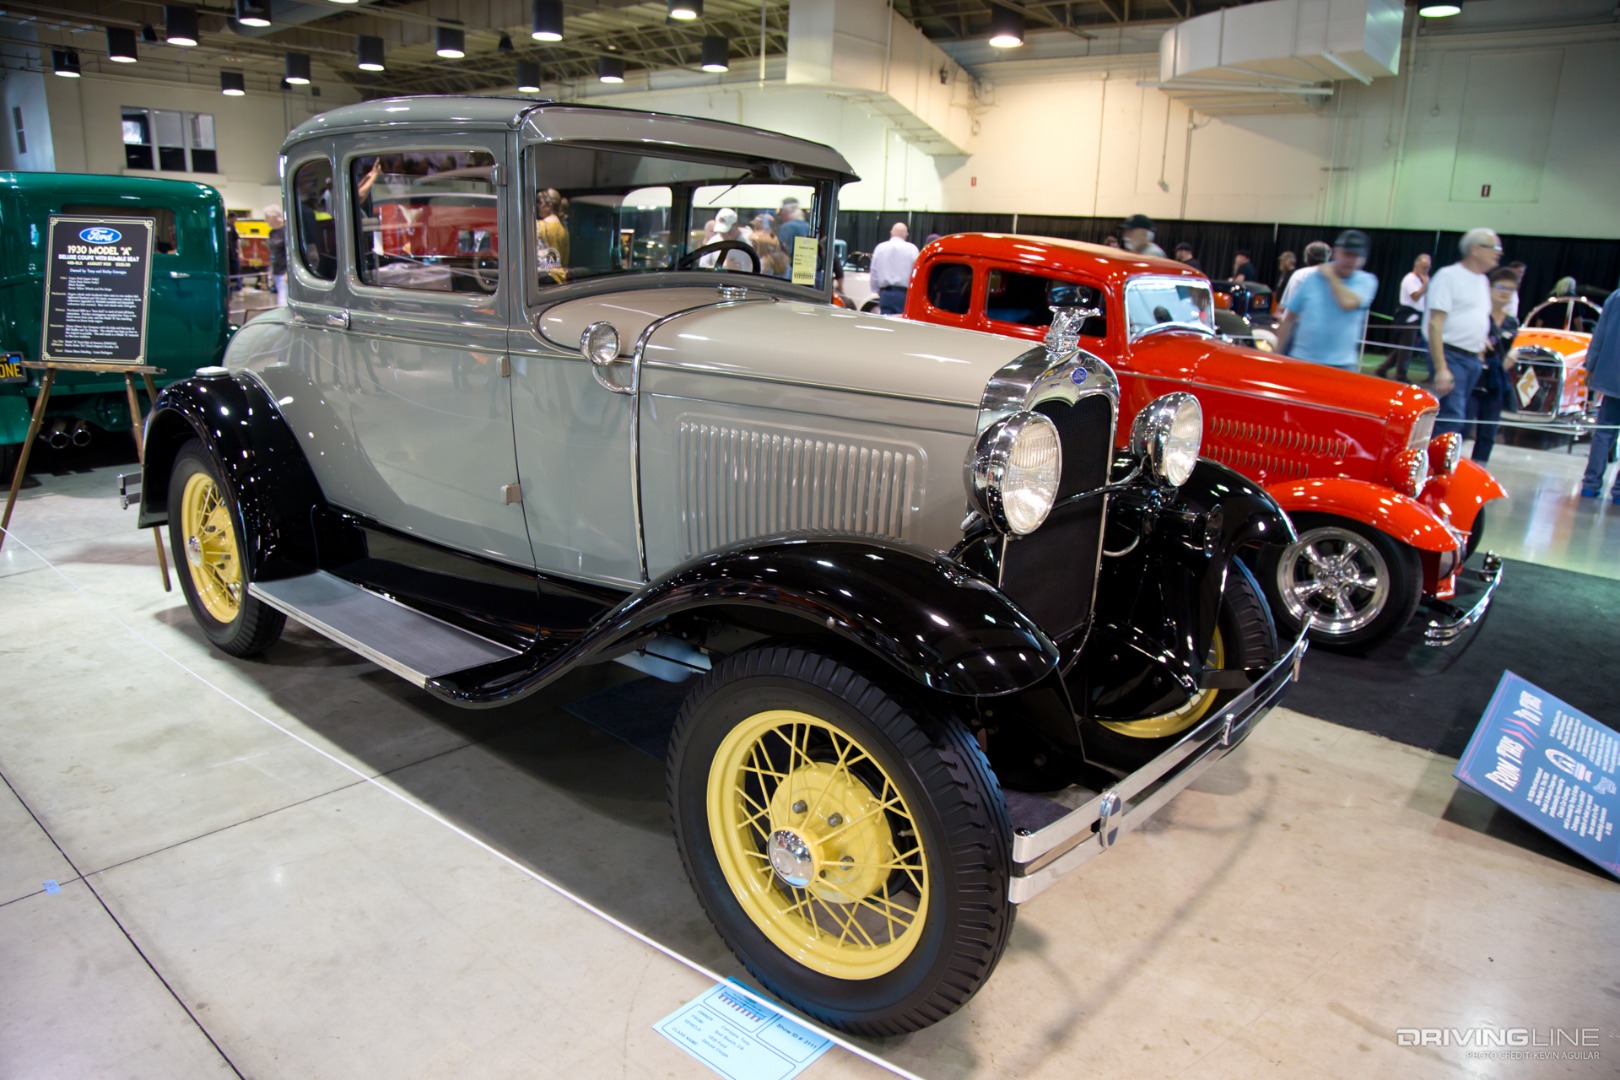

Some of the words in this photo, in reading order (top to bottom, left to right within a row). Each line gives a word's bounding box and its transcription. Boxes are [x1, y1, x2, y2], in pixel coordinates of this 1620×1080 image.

[87, 229, 114, 241] Ford
[67, 245, 88, 254] 1930
[88, 246, 119, 255] MODEL
